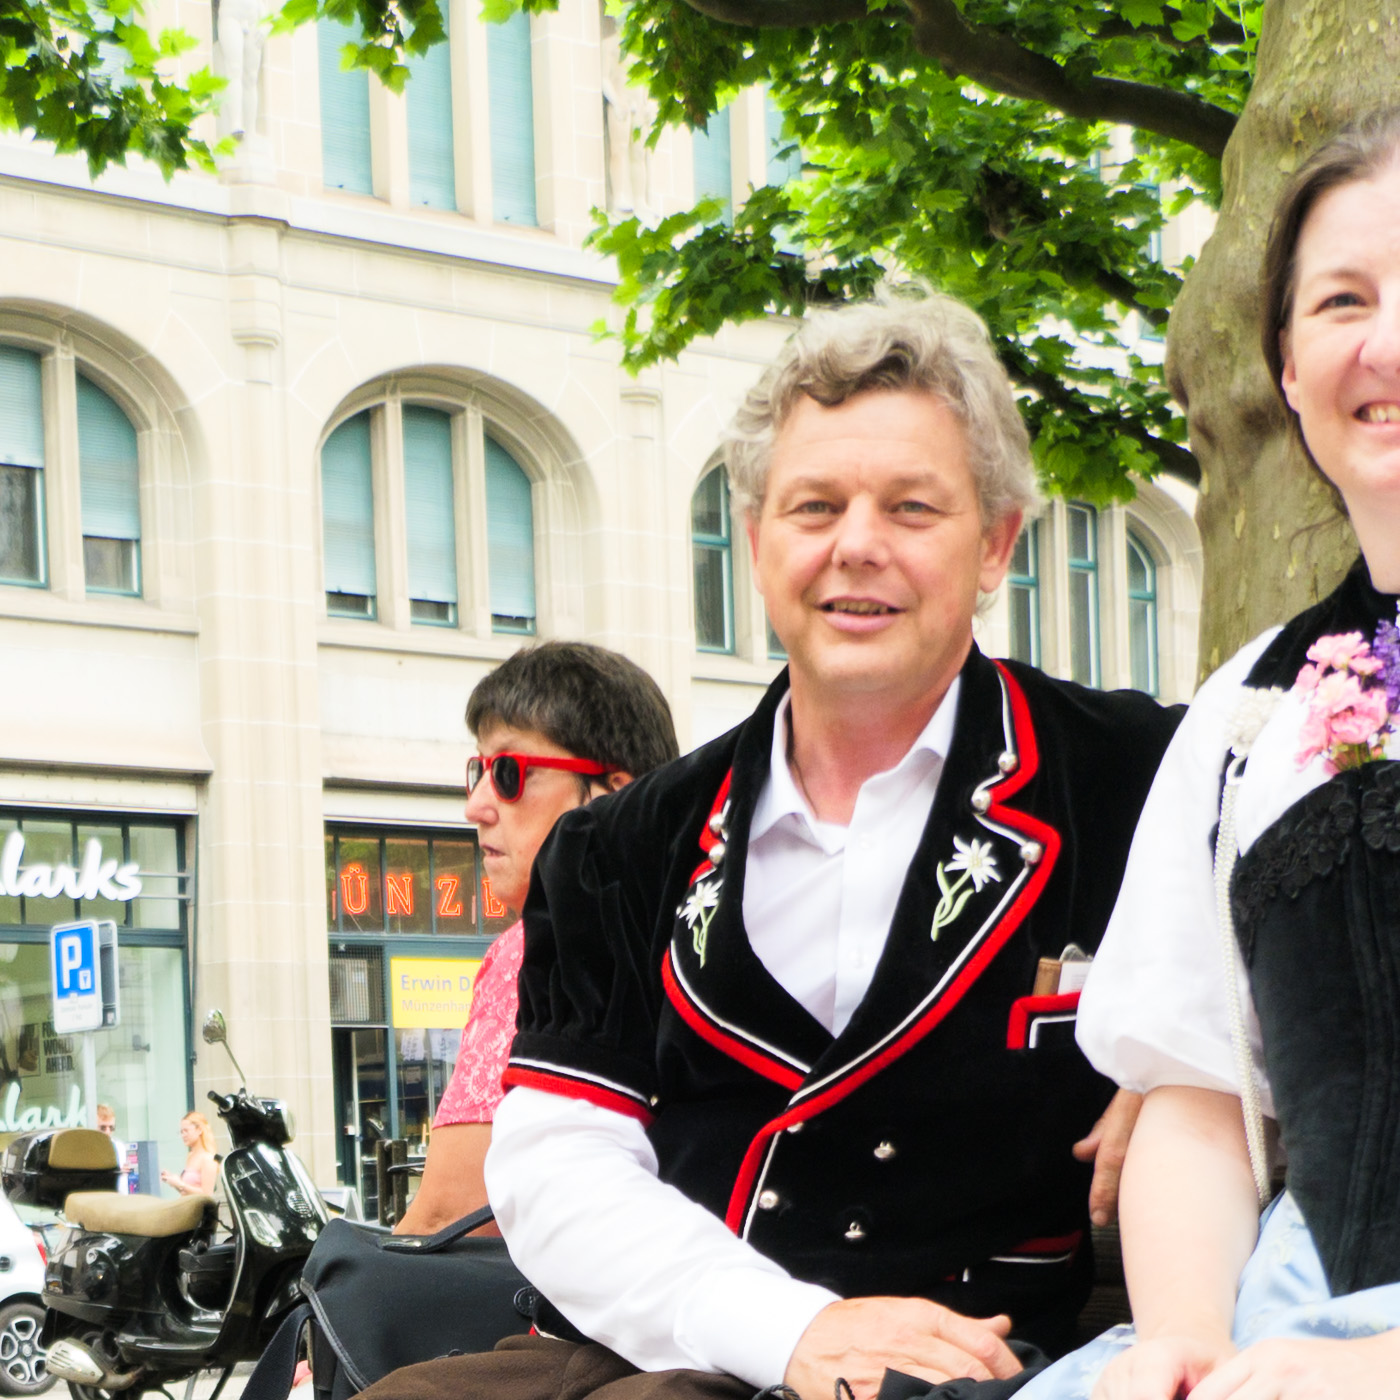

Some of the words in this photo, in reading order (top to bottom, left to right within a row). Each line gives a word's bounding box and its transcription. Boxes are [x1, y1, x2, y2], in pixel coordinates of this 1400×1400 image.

[61, 936, 82, 989] P
[400, 974, 452, 991] Erwin
[43, 1037, 75, 1056] WORLD
